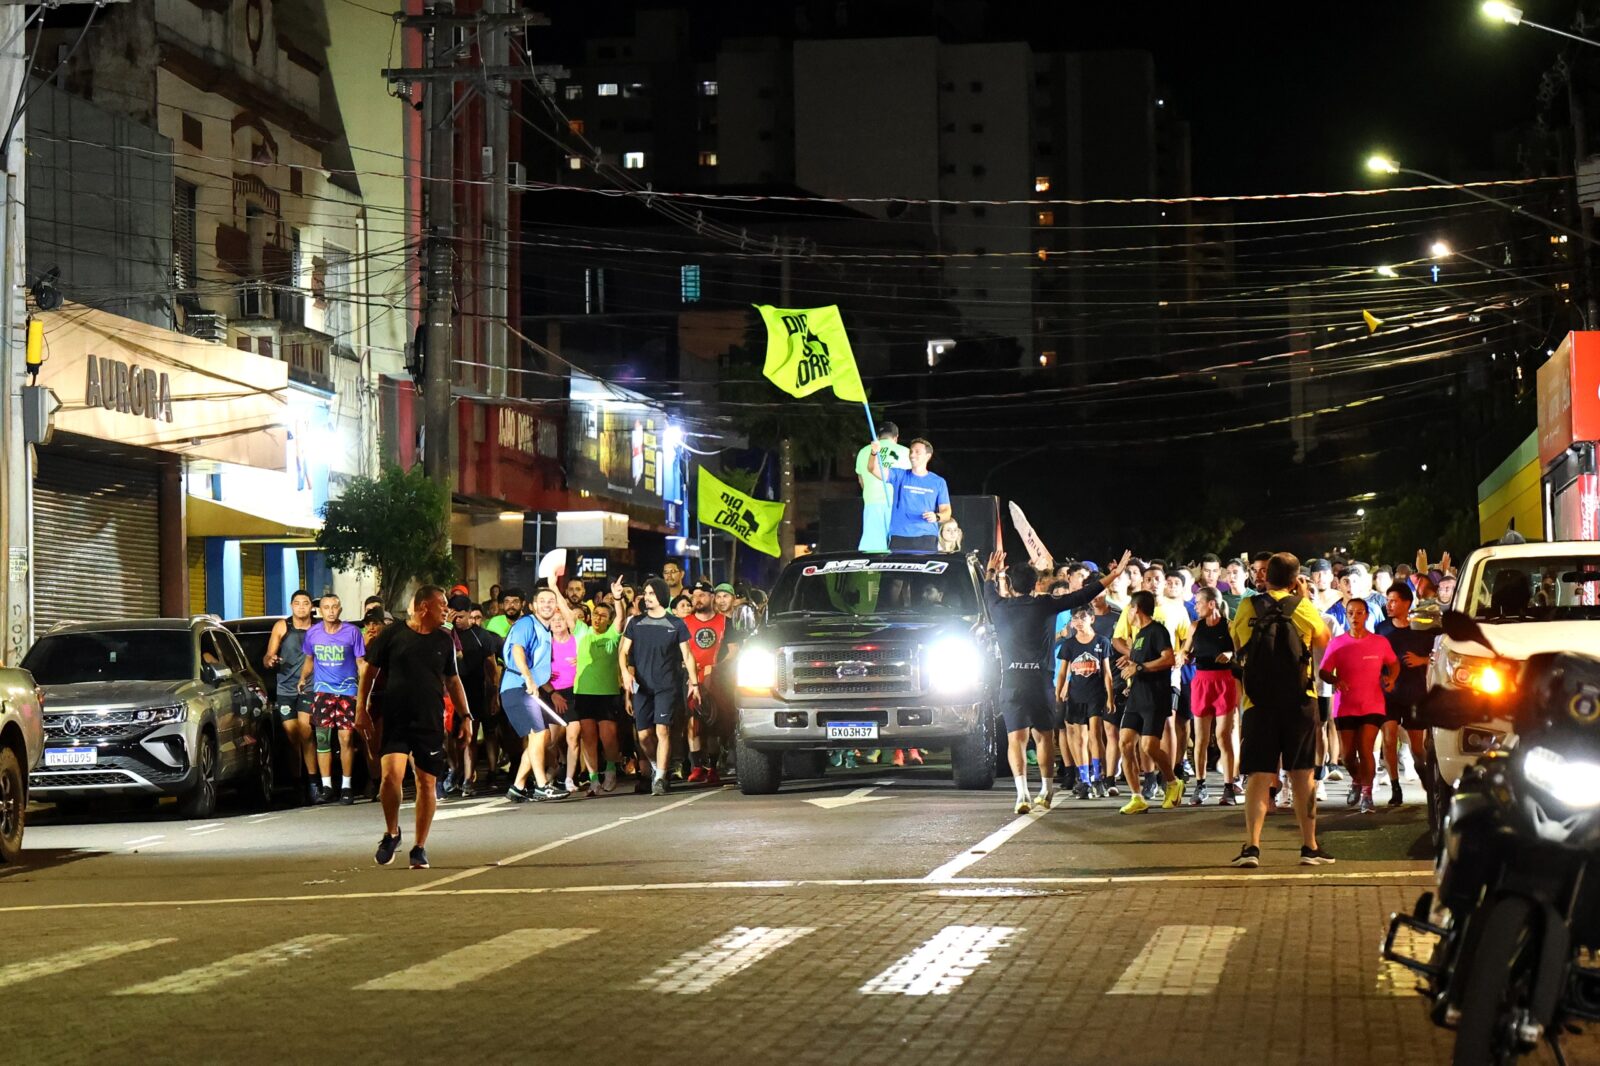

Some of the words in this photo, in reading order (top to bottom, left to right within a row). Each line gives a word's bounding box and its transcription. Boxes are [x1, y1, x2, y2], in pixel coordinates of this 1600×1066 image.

[85, 354, 173, 423] AURORA
[720, 492, 744, 511] DIA
[714, 510, 752, 541] CORRE
[582, 558, 607, 572] REI
[314, 644, 344, 653] PAN
[1008, 662, 1040, 670] ATLETA
